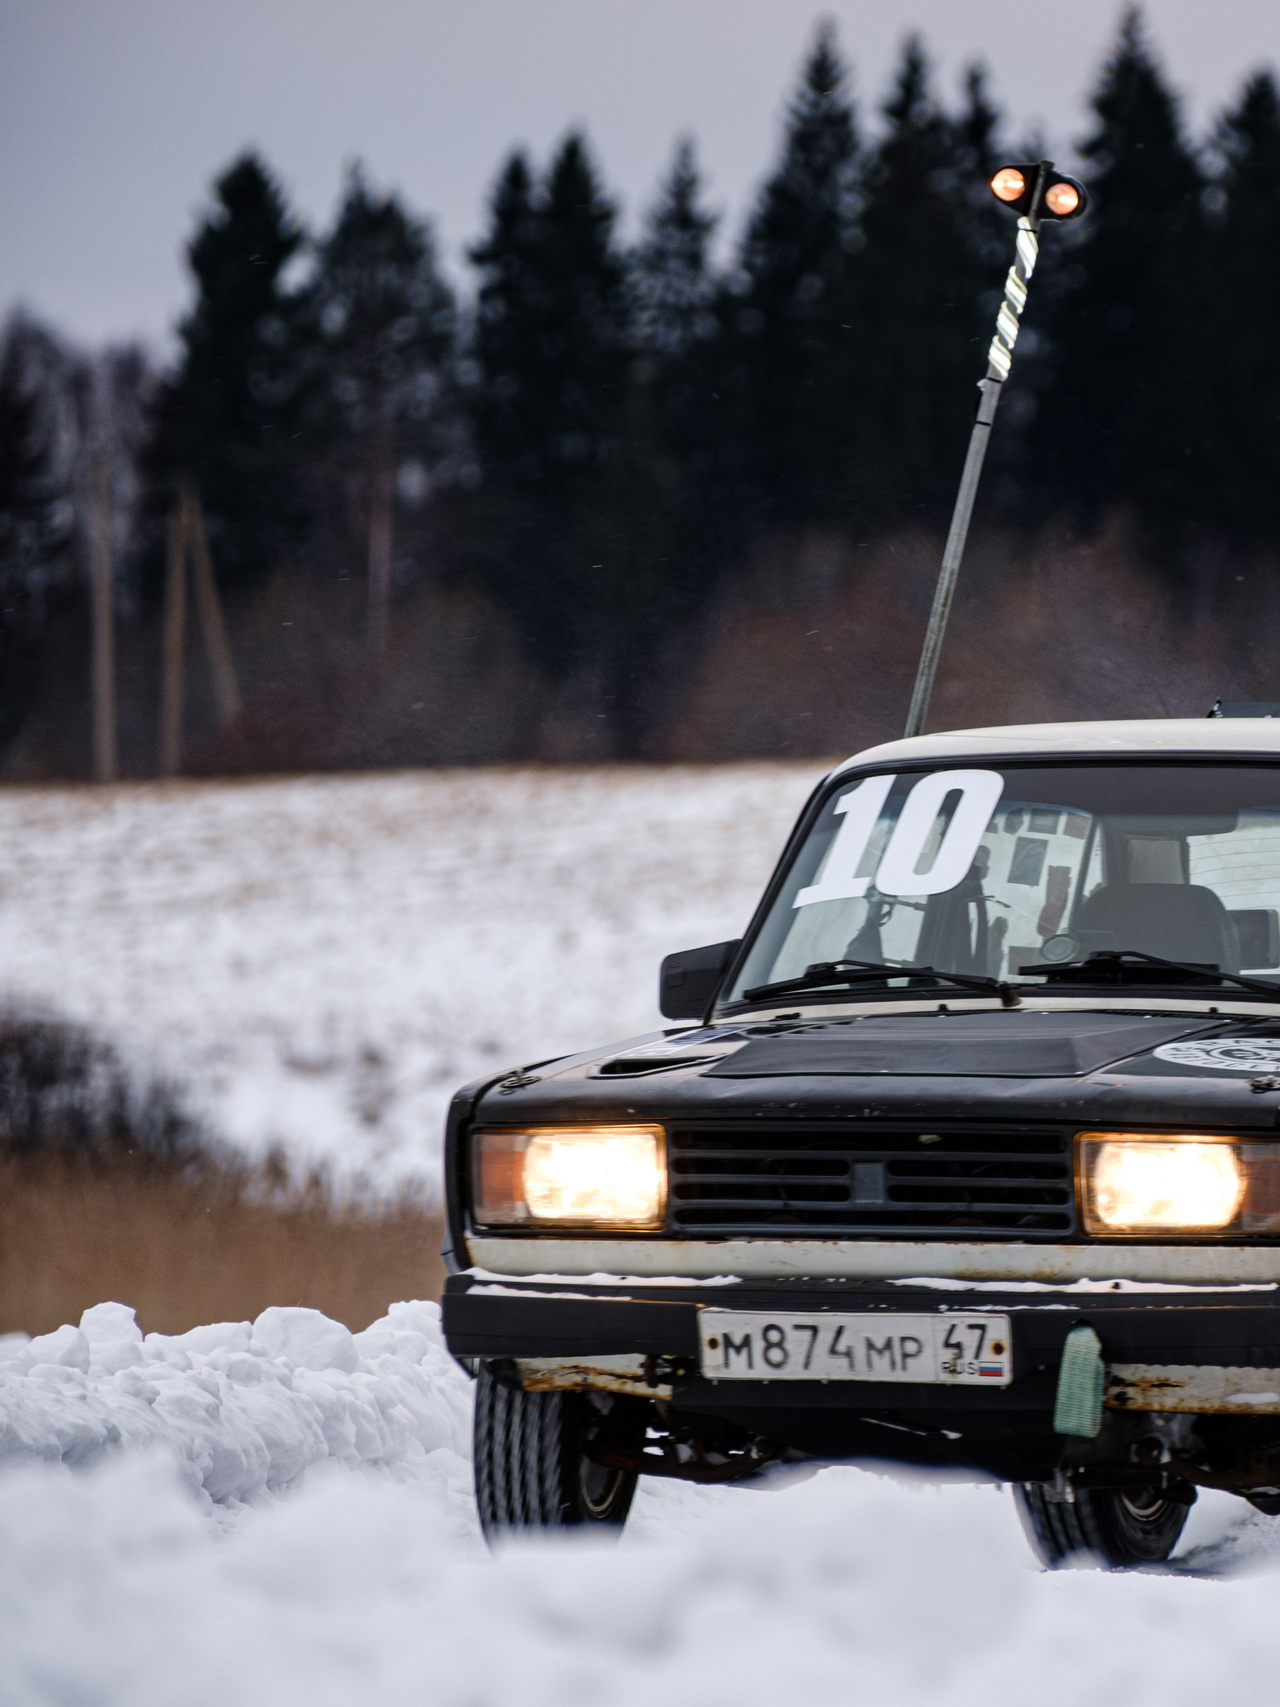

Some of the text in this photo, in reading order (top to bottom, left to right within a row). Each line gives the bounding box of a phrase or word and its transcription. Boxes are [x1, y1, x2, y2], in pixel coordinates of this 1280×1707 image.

[792, 769, 1005, 909] 10
[942, 1324, 988, 1361] 47
[941, 1361, 979, 1375] RUS
